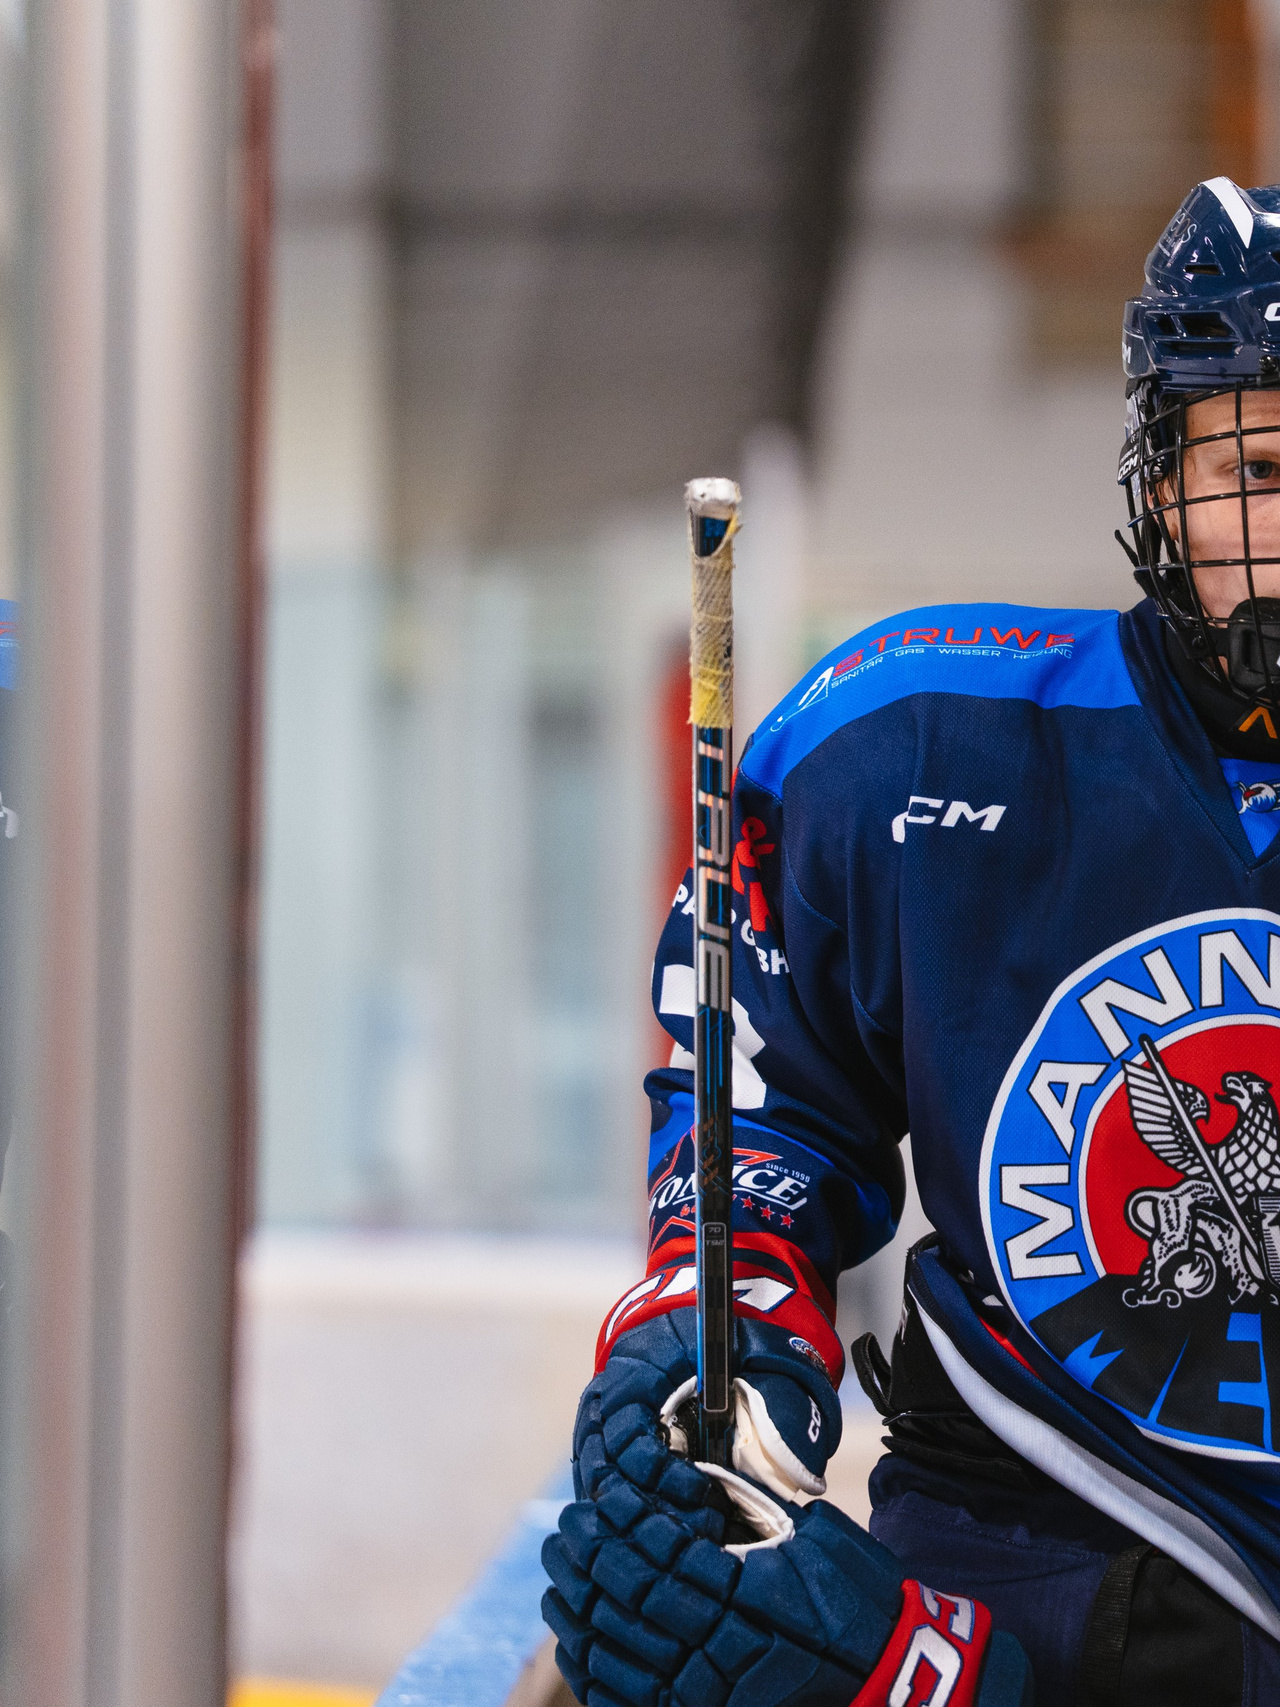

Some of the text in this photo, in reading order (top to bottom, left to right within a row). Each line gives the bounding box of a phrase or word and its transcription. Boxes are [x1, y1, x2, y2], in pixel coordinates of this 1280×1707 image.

[895, 647, 925, 657] GAS
[938, 648, 1001, 657] WASSER
[765, 1162, 789, 1175] since
